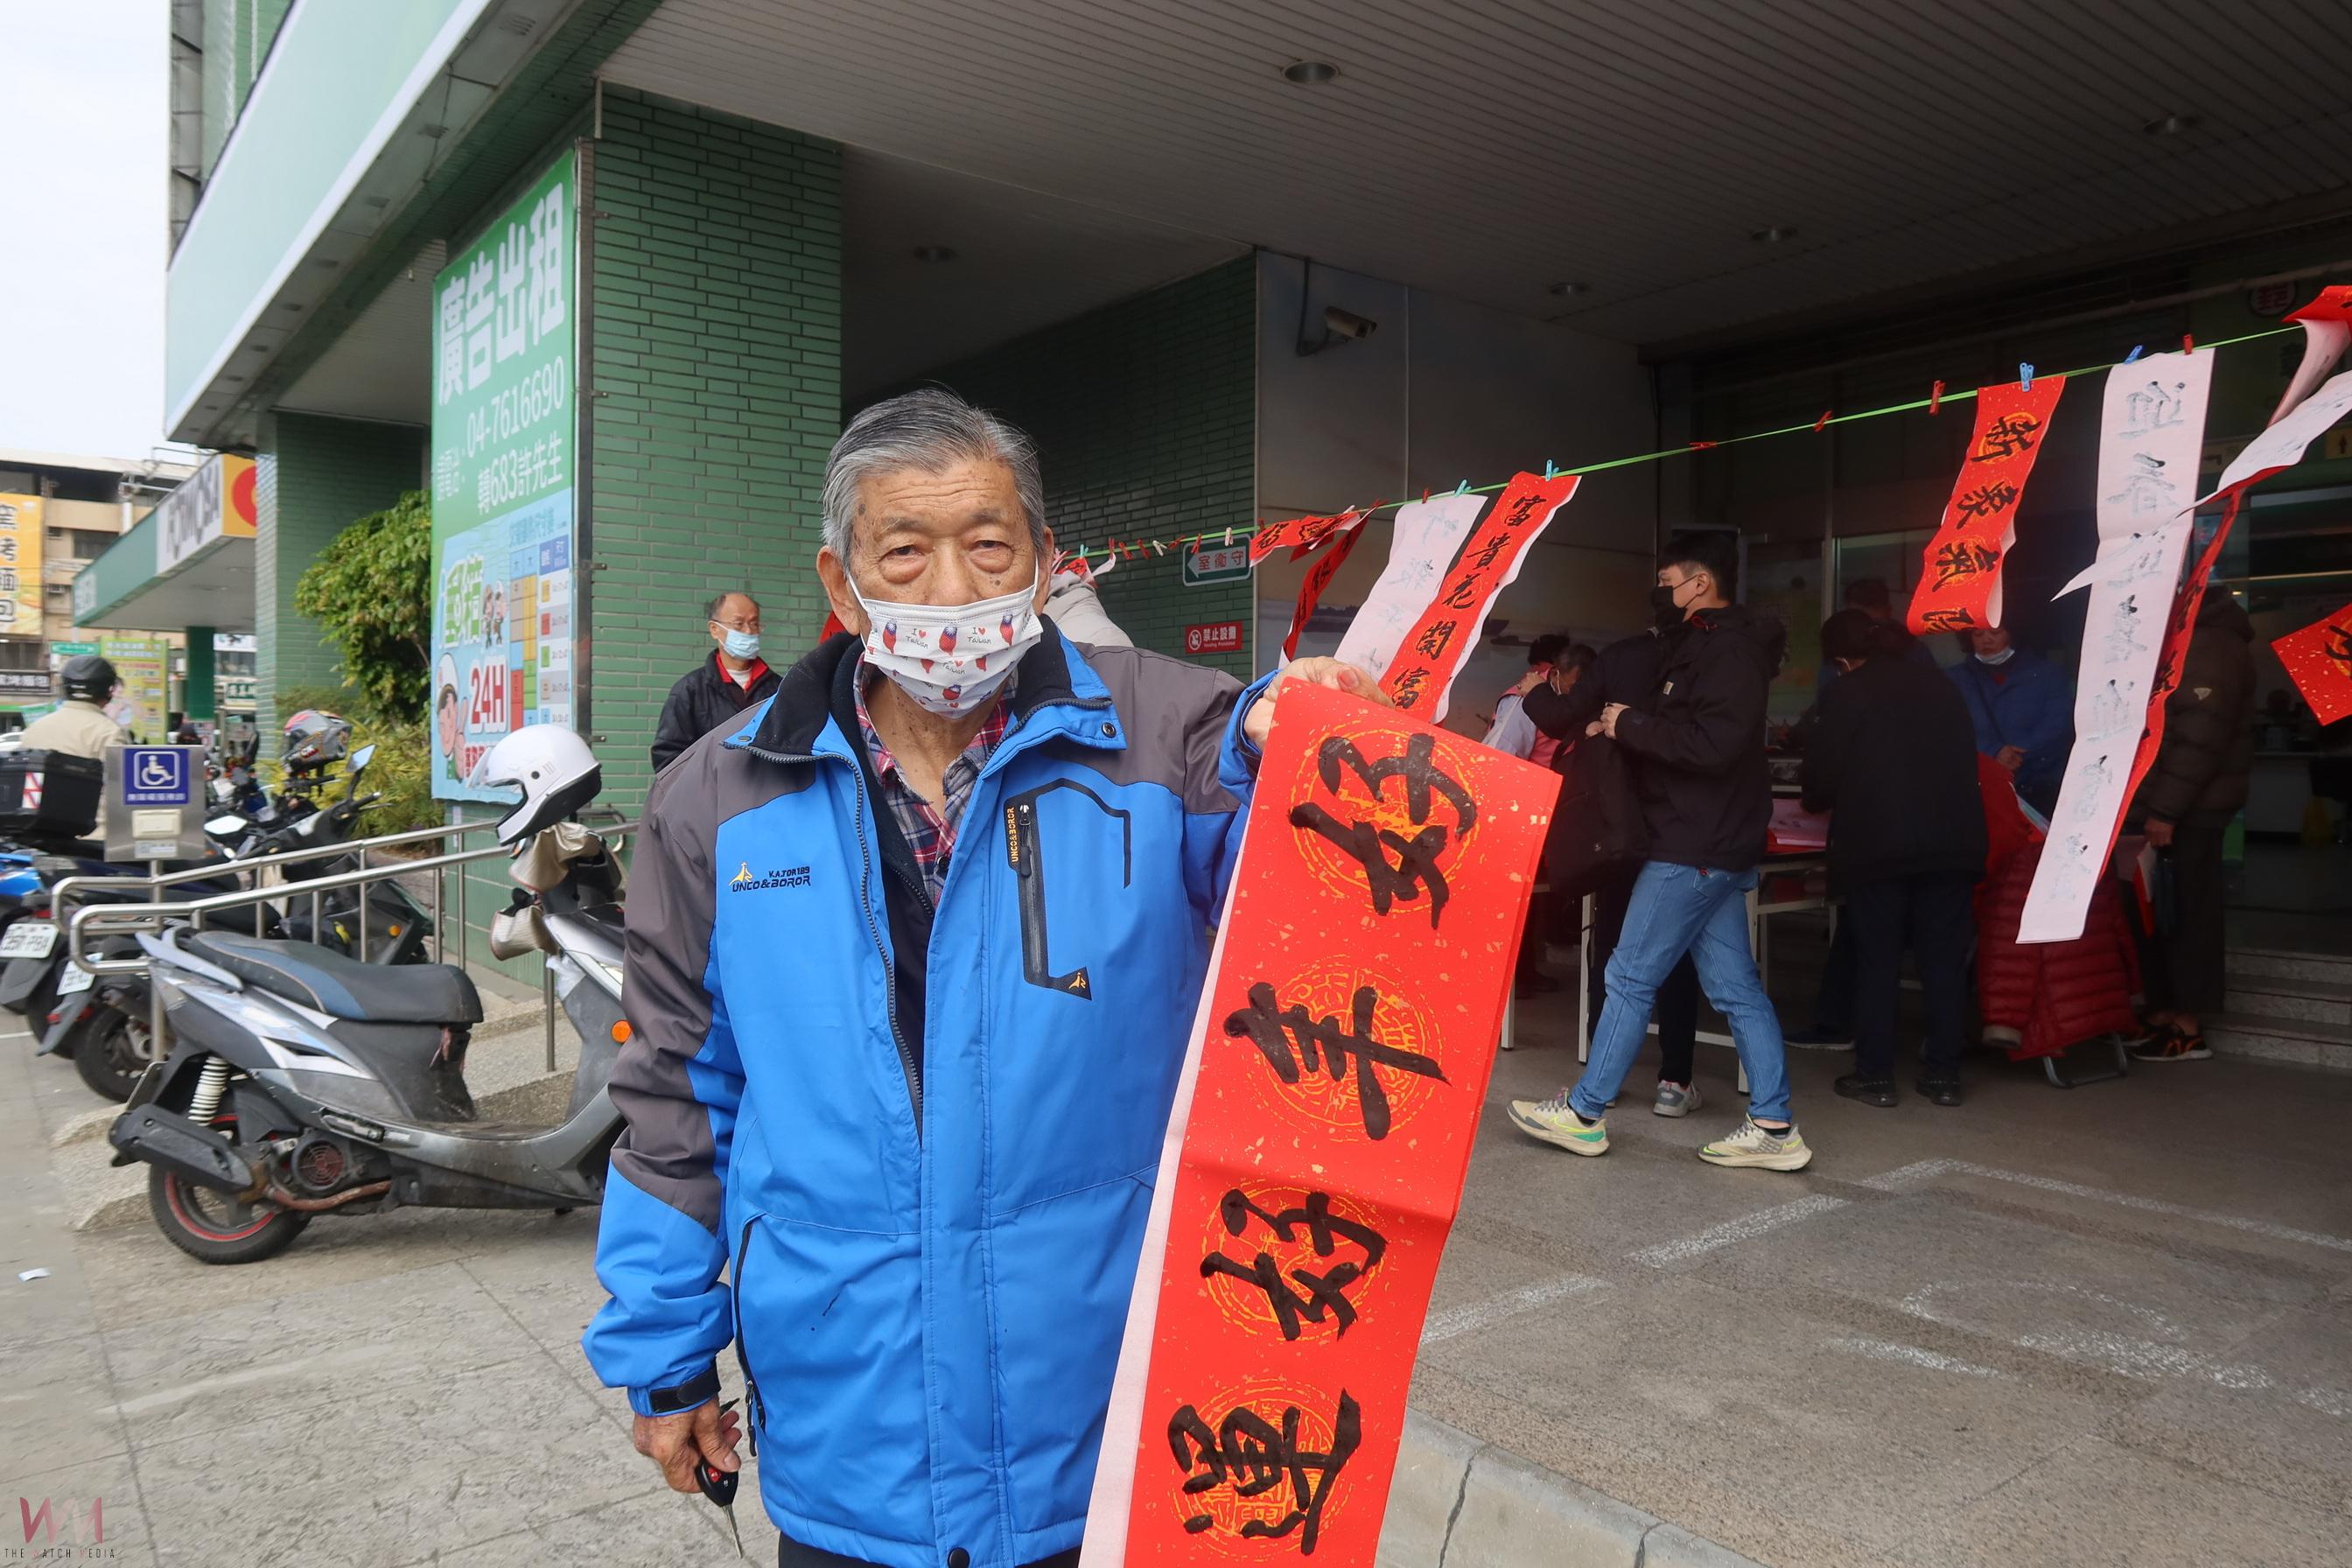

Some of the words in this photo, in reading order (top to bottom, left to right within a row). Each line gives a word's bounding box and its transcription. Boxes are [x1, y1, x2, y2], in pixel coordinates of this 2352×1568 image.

[438, 182, 565, 406] 廣告出租
[466, 355, 564, 458] 04-7616690
[906, 635, 928, 649] Taiwan
[967, 636, 991, 645] Taiwan
[1203, 626, 1236, 642] 禁止設攤
[471, 664, 504, 724] 24H
[732, 875, 811, 892] UNCO&BOROR
